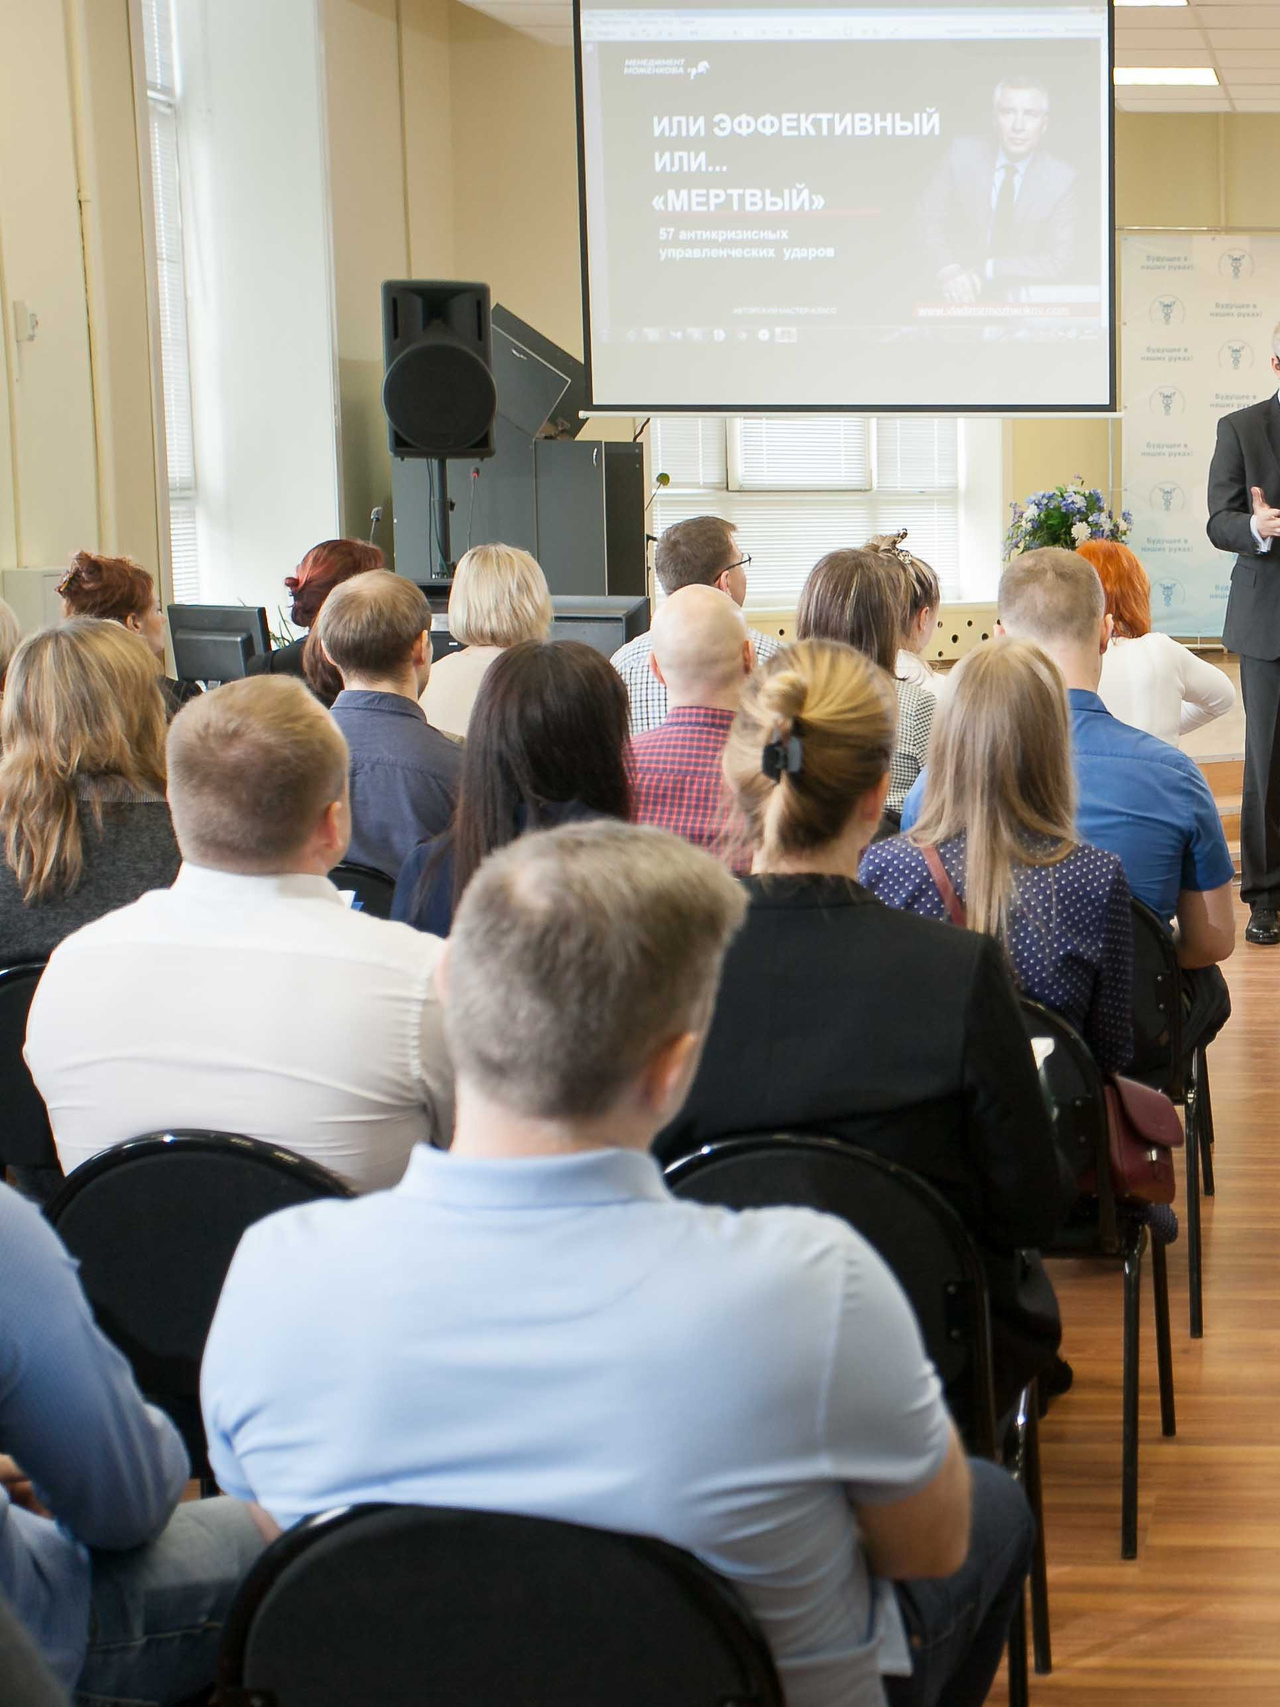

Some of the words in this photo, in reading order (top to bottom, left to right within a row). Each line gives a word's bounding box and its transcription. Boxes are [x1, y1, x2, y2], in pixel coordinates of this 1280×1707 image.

[652, 115, 705, 137] ИЛИ
[713, 107, 940, 137] ЭФФЕКТИВНЫЙ
[654, 151, 728, 172] ИЛИ...
[651, 183, 826, 212] «МЕРТВЫЙ»
[658, 228, 674, 240] 57
[679, 229, 789, 242] антикризисных
[659, 247, 775, 261] управленческих
[783, 247, 835, 260] ударов
